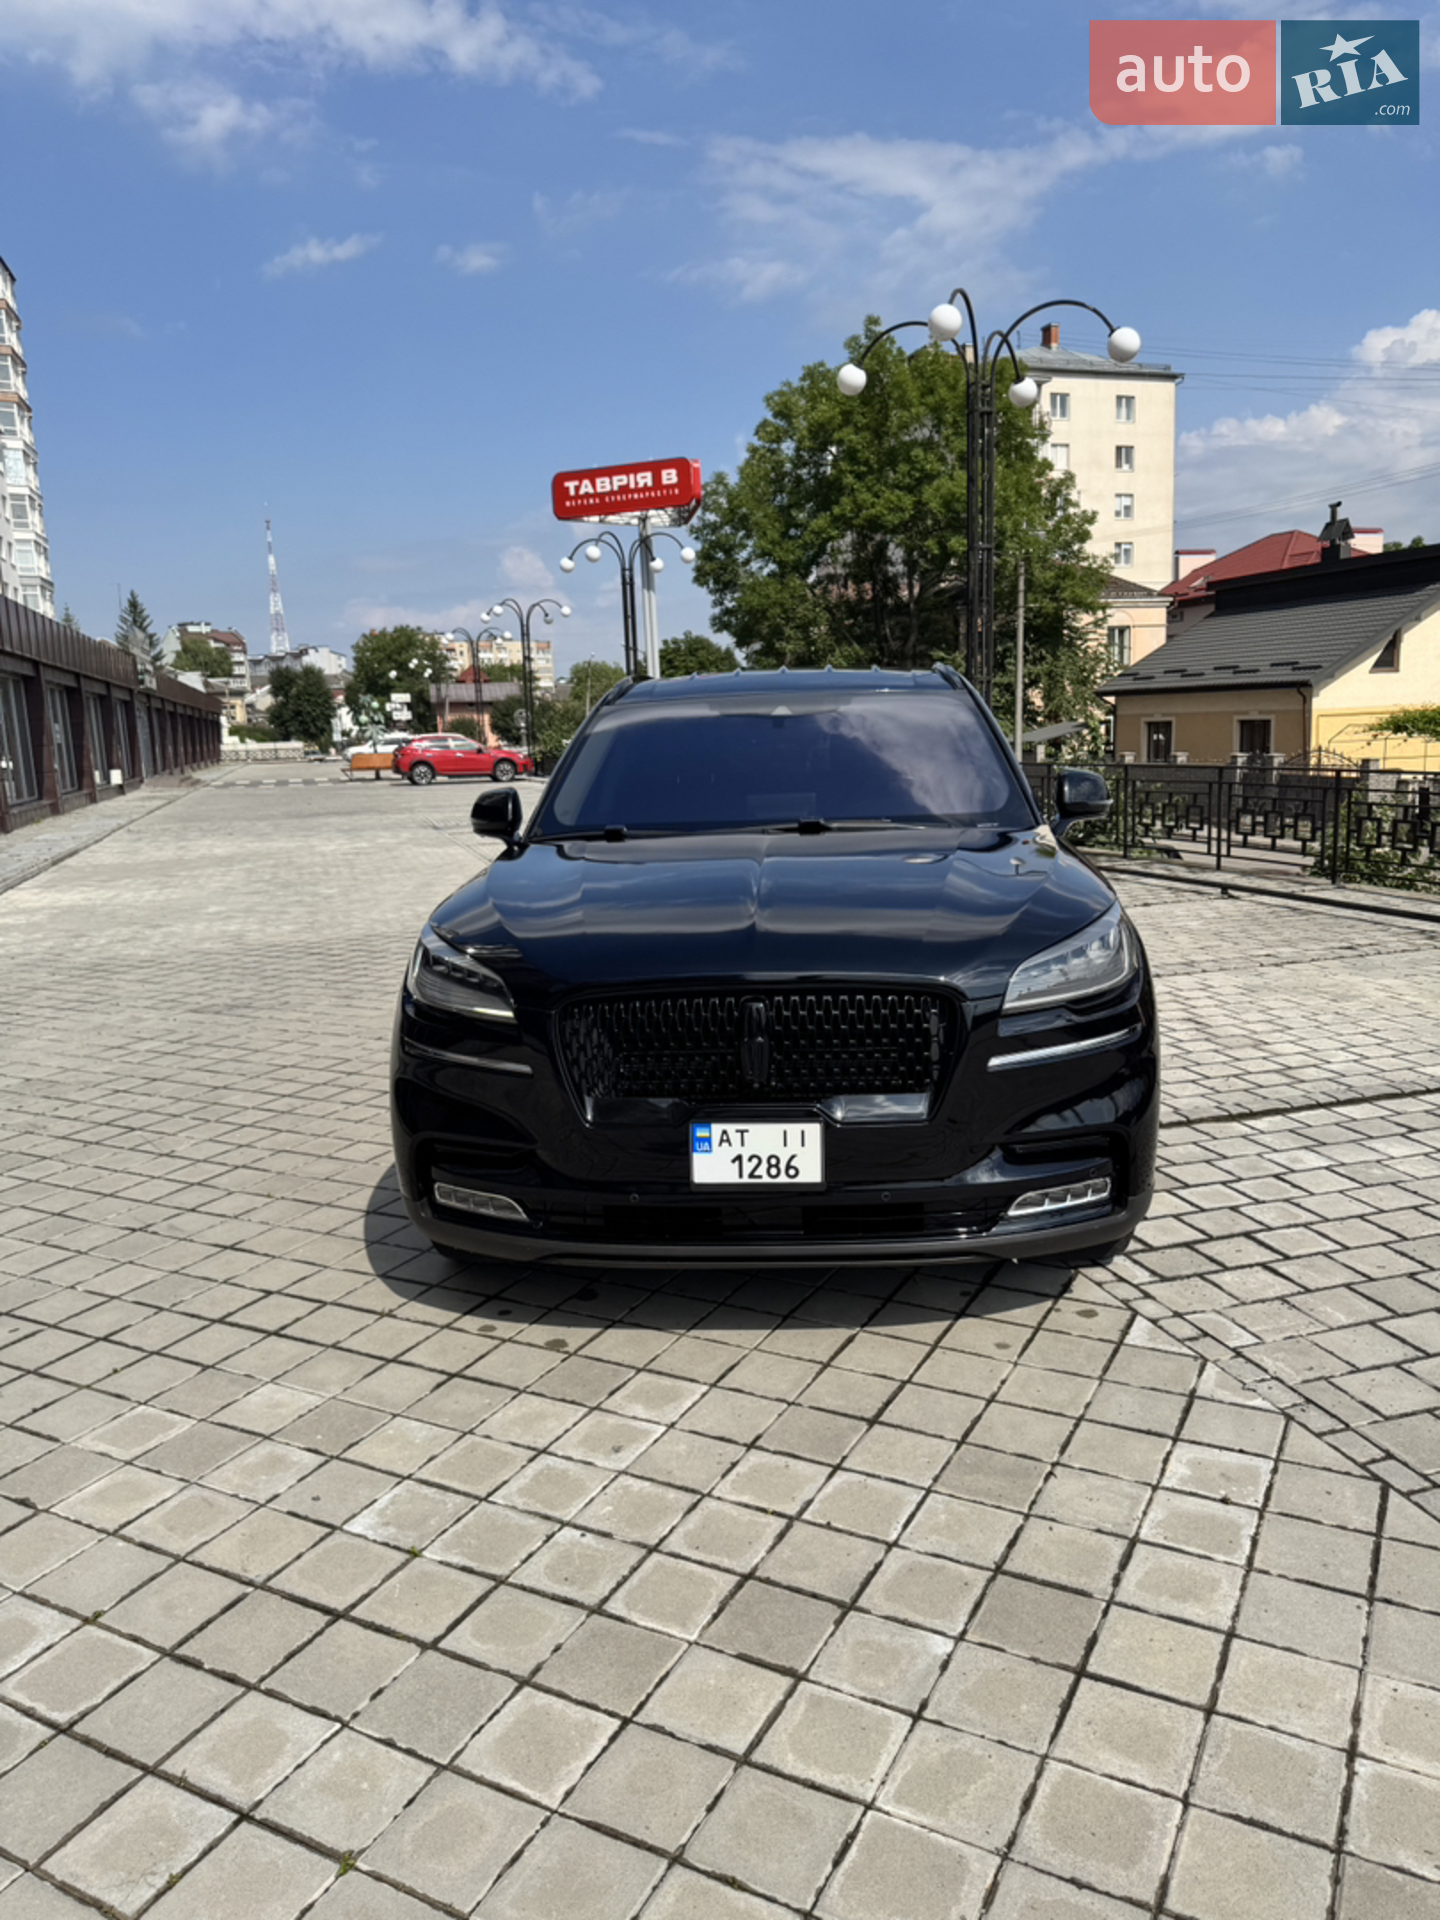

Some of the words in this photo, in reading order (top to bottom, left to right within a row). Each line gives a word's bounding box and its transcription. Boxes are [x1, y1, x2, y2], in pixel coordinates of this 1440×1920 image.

[563, 471, 653, 497] ТАВРІЯ
[661, 468, 678, 485] В
[696, 1141, 711, 1151] UA
[718, 1129, 750, 1147] AT
[730, 1154, 800, 1179] 1286
